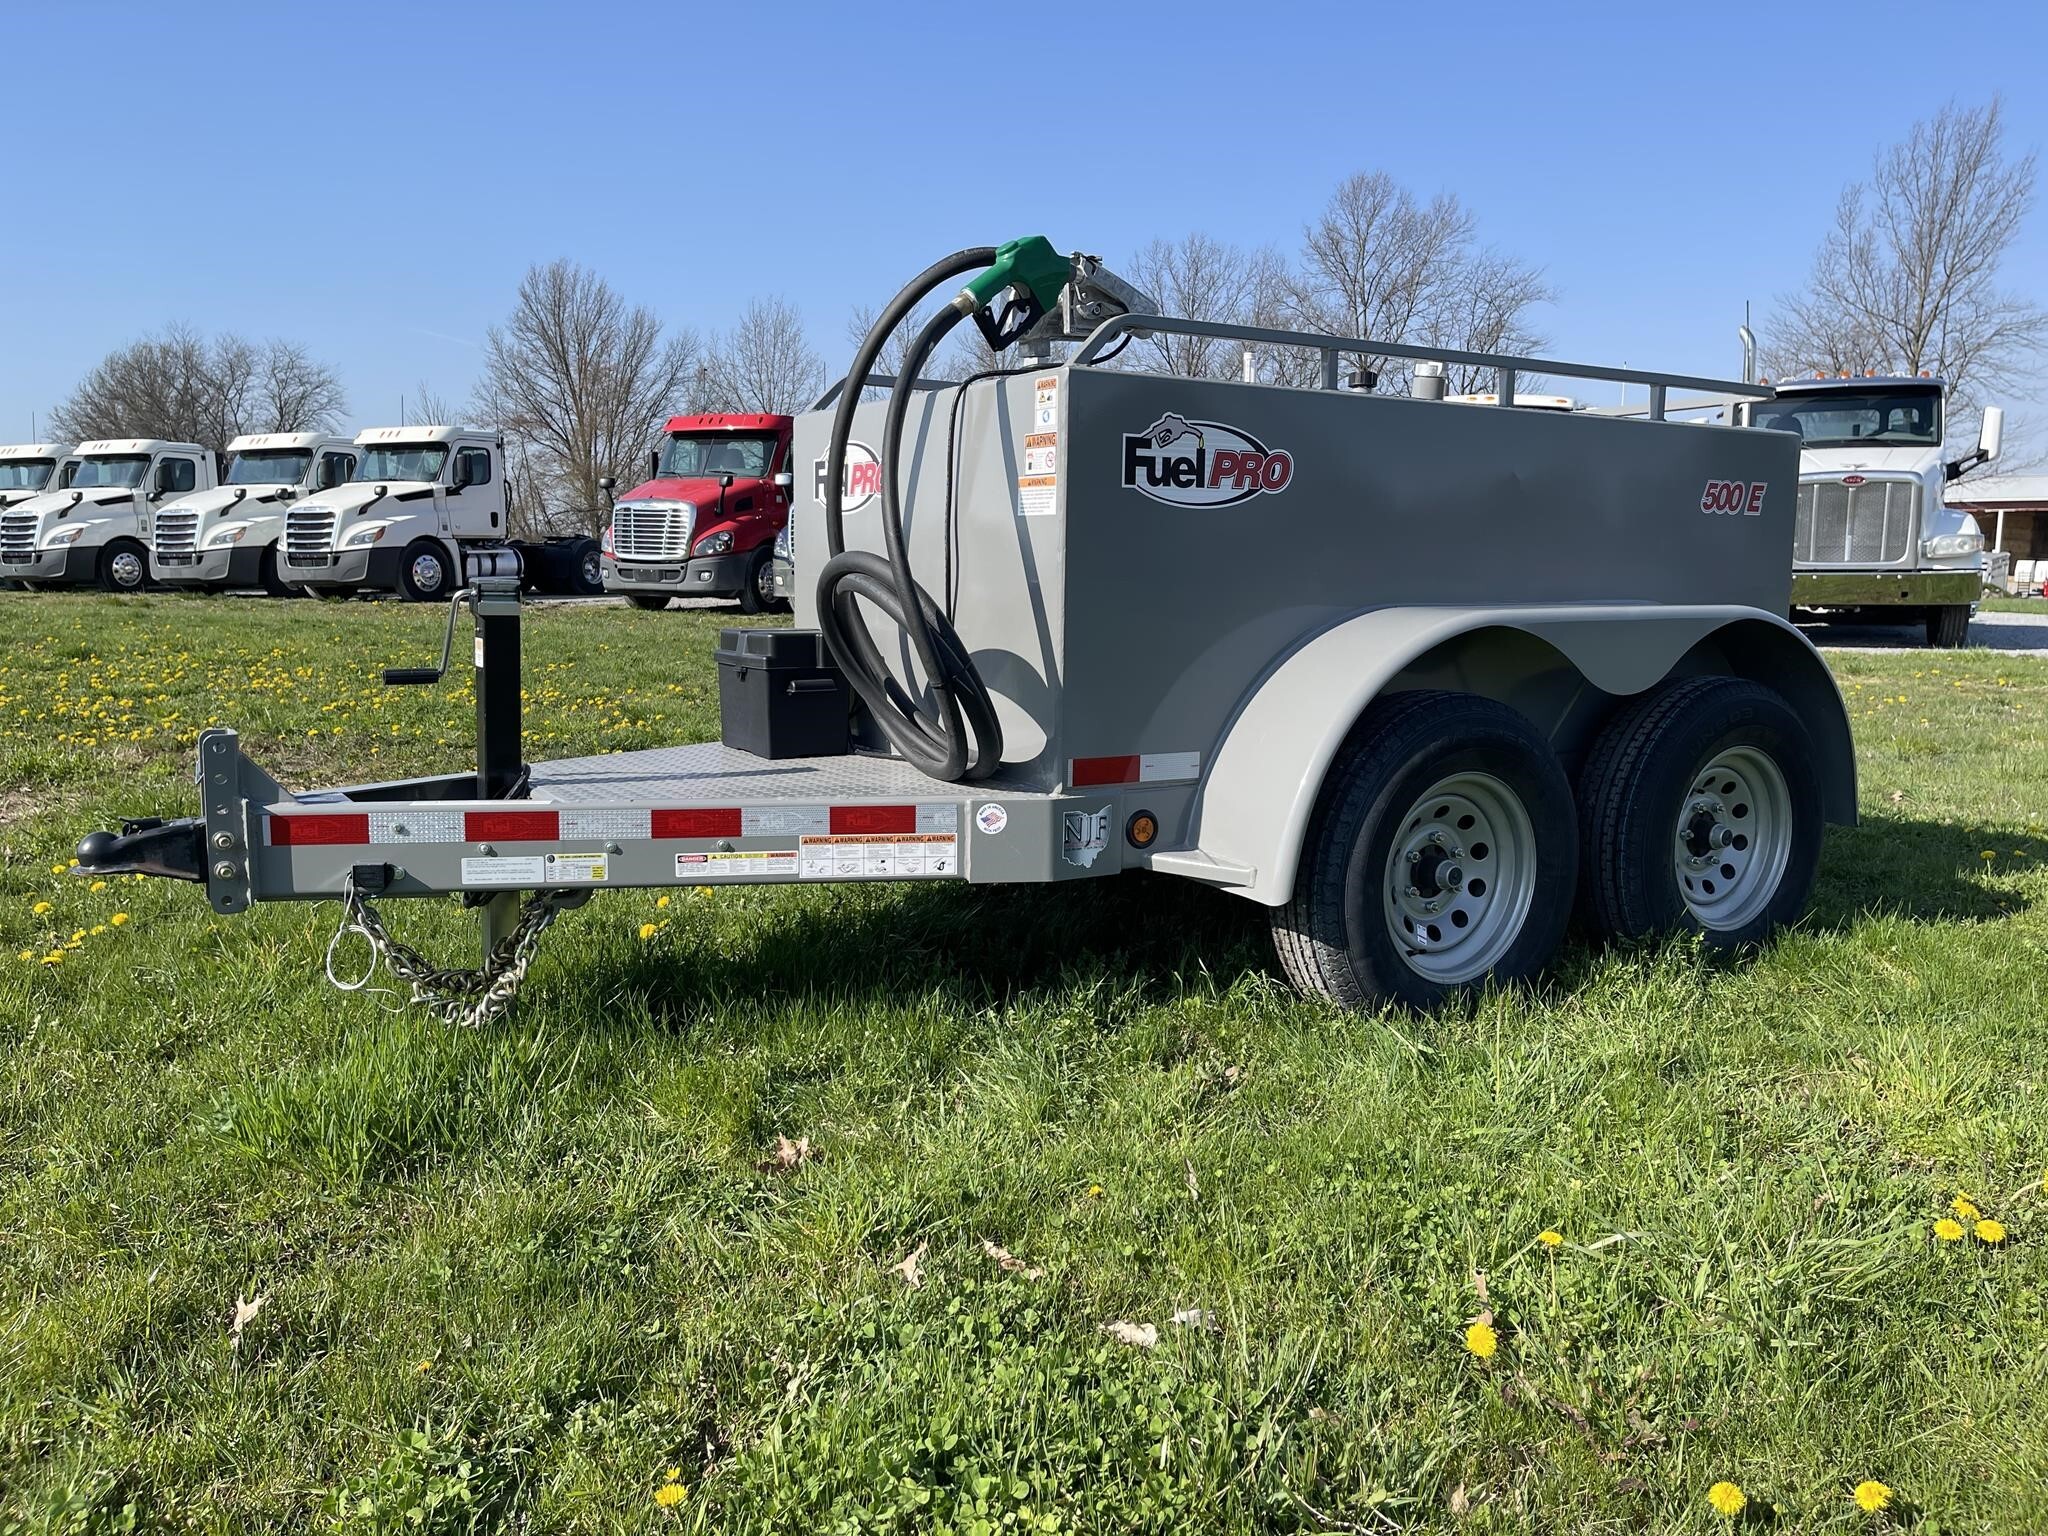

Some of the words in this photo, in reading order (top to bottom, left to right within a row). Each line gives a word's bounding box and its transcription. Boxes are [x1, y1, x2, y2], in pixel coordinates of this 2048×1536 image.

[1702, 481, 1744, 514] 500
[1746, 482, 1768, 516] E
[1064, 815, 1107, 847] NJF
